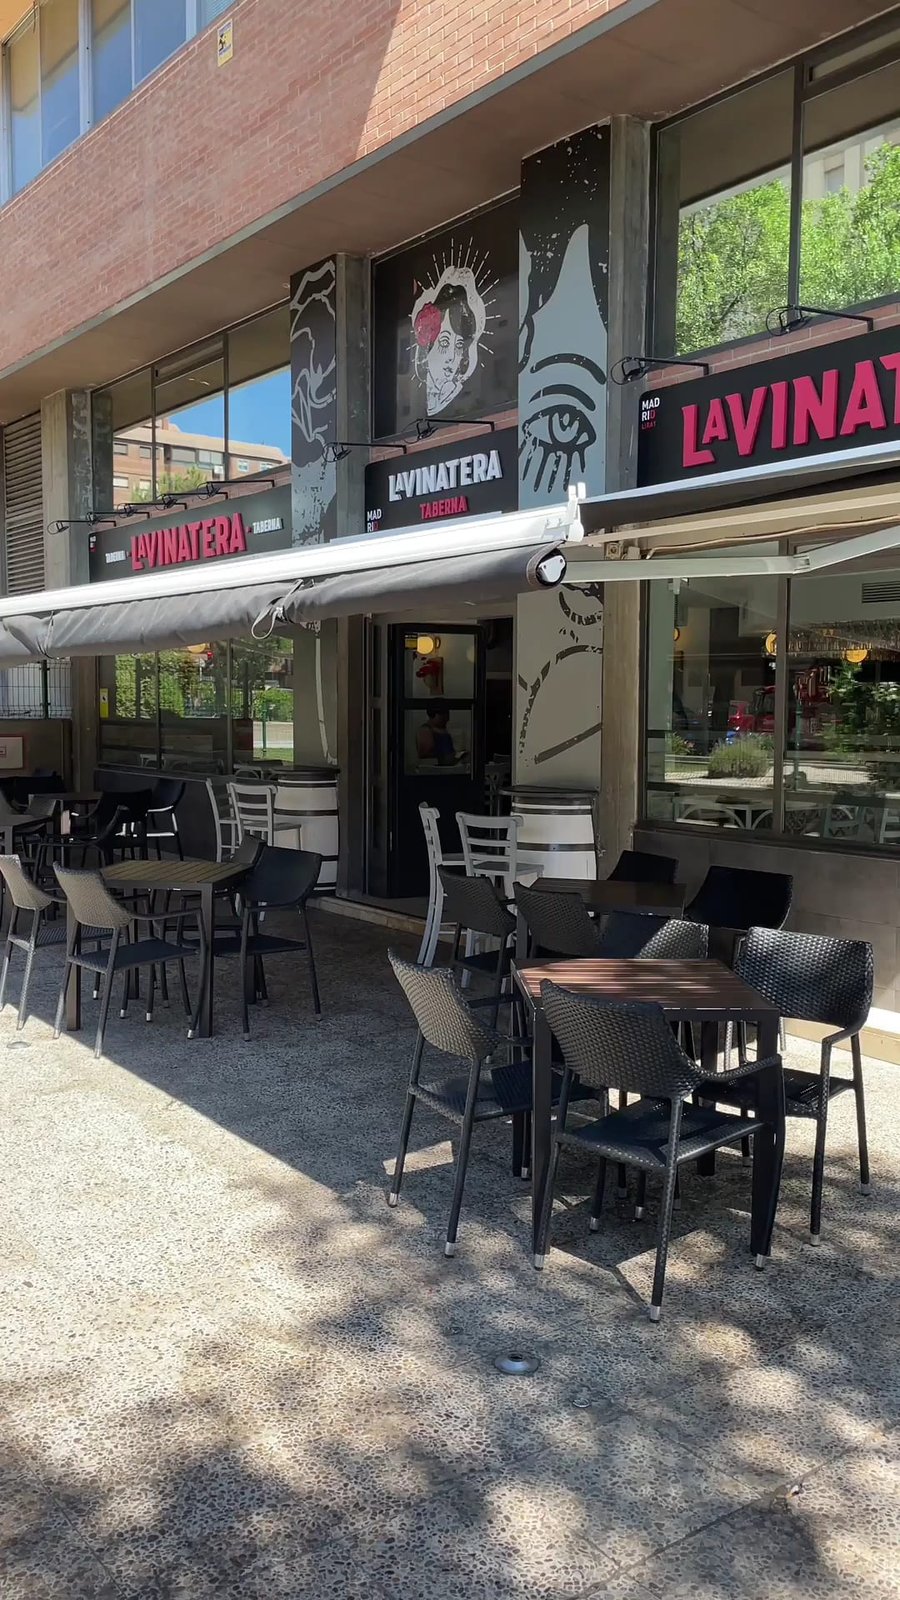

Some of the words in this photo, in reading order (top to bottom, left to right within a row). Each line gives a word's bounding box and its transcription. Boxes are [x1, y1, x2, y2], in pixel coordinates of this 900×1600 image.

[641, 397, 660, 410] MAD
[641, 410, 656, 421] RID
[366, 508, 382, 521] MAD
[419, 496, 468, 520] TABERNA
